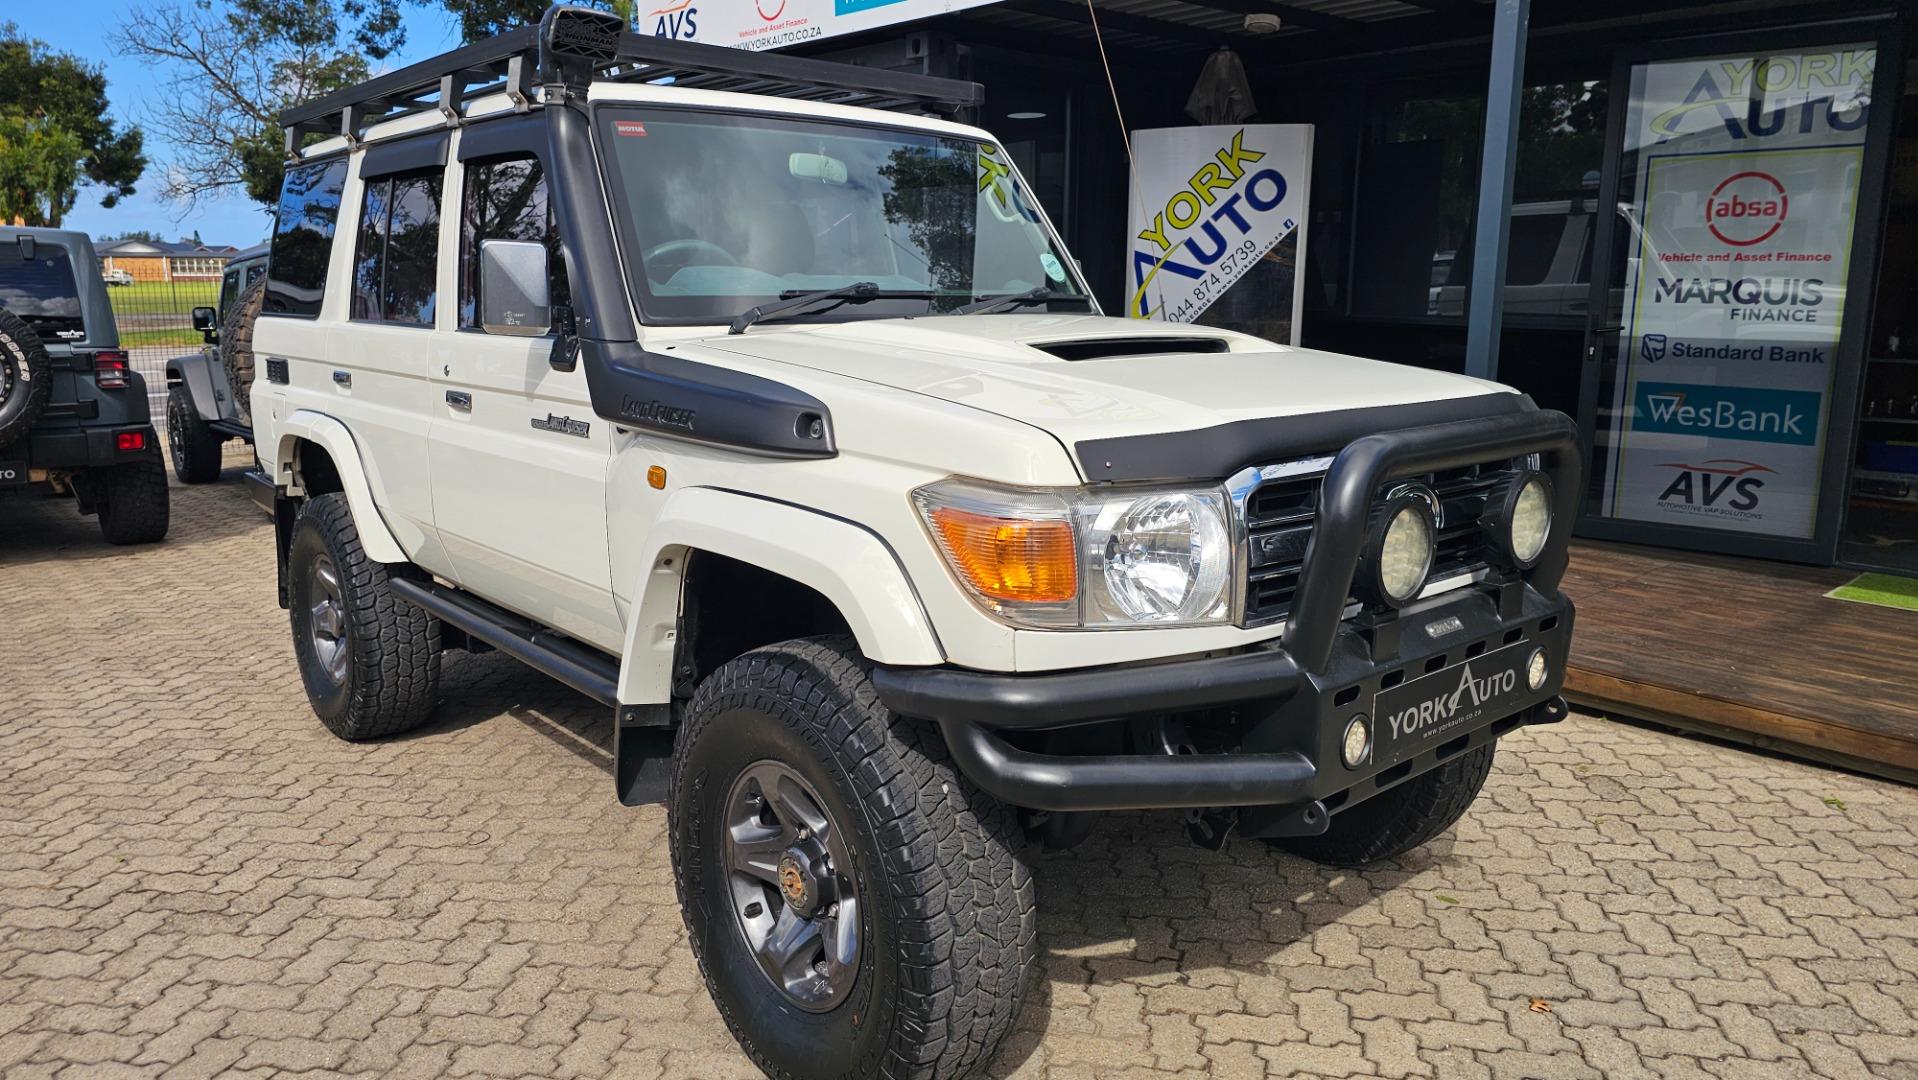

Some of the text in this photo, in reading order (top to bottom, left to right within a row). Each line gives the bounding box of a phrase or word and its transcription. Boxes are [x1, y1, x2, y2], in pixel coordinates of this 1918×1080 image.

[654, 8, 698, 40] AVS
[730, 26, 822, 50] W.YORKAUTO.CO.ZA
[739, 18, 808, 38] Vehicle and Asset Finance
[1720, 48, 1877, 96] YORK
[1653, 68, 1872, 145] AUTO
[1137, 128, 1267, 252] YORK
[1714, 194, 1778, 218] absa
[1133, 168, 1288, 318] AUTO
[1658, 251, 1832, 262] Vehicle and Asset Finance
[1168, 240, 1257, 323] 044 874 5739
[1185, 232, 1283, 323] GEORGE www.yorkauto.co.za
[1654, 277, 1824, 306] MARQUIS
[1730, 308, 1818, 323] FINANCE
[0, 330, 30, 381] OOPER
[1671, 341, 1825, 364] Standard Bank
[1647, 394, 1804, 435] WesBank
[1657, 470, 1766, 511] AVS
[1422, 709, 1482, 738] www.yorkauto.co.za
